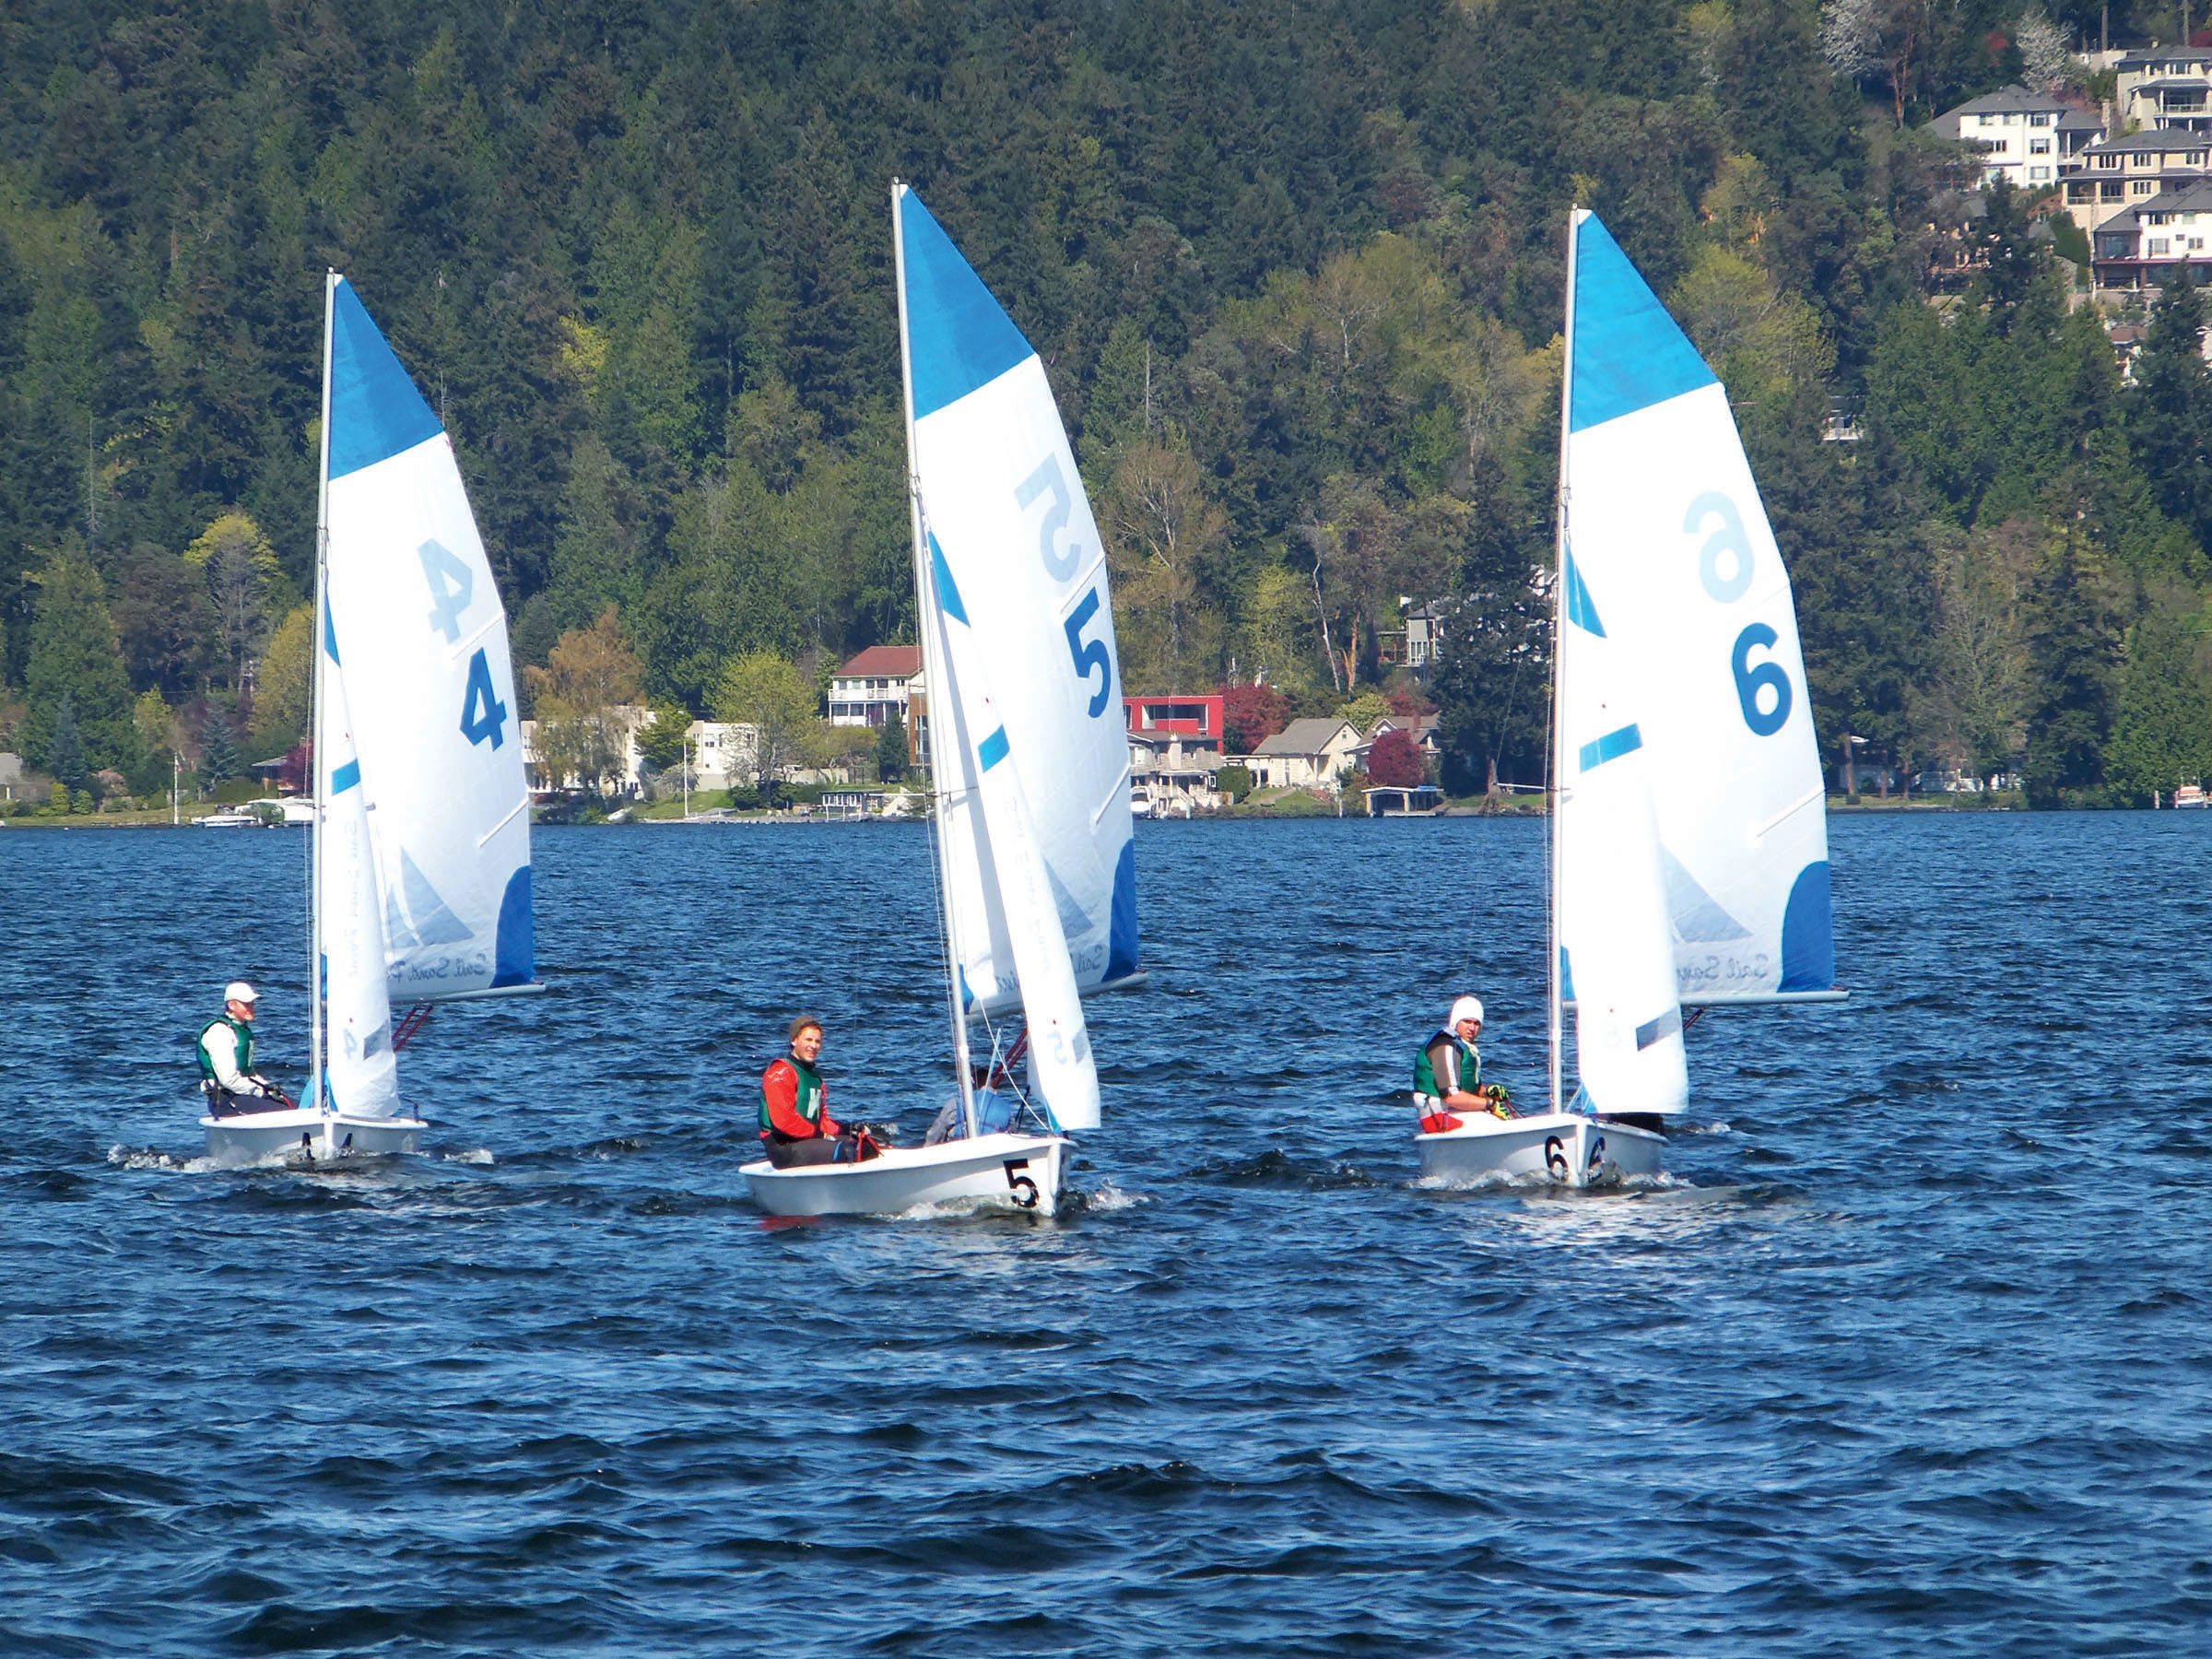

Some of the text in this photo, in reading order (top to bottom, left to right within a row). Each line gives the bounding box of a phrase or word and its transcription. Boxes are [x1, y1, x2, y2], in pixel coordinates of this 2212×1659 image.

[460, 647, 507, 752] 4
[1064, 586, 1111, 719] 5
[1732, 622, 1792, 736] 6
[1003, 1158, 1040, 1208] 5
[1545, 1135, 1569, 1182] 6
